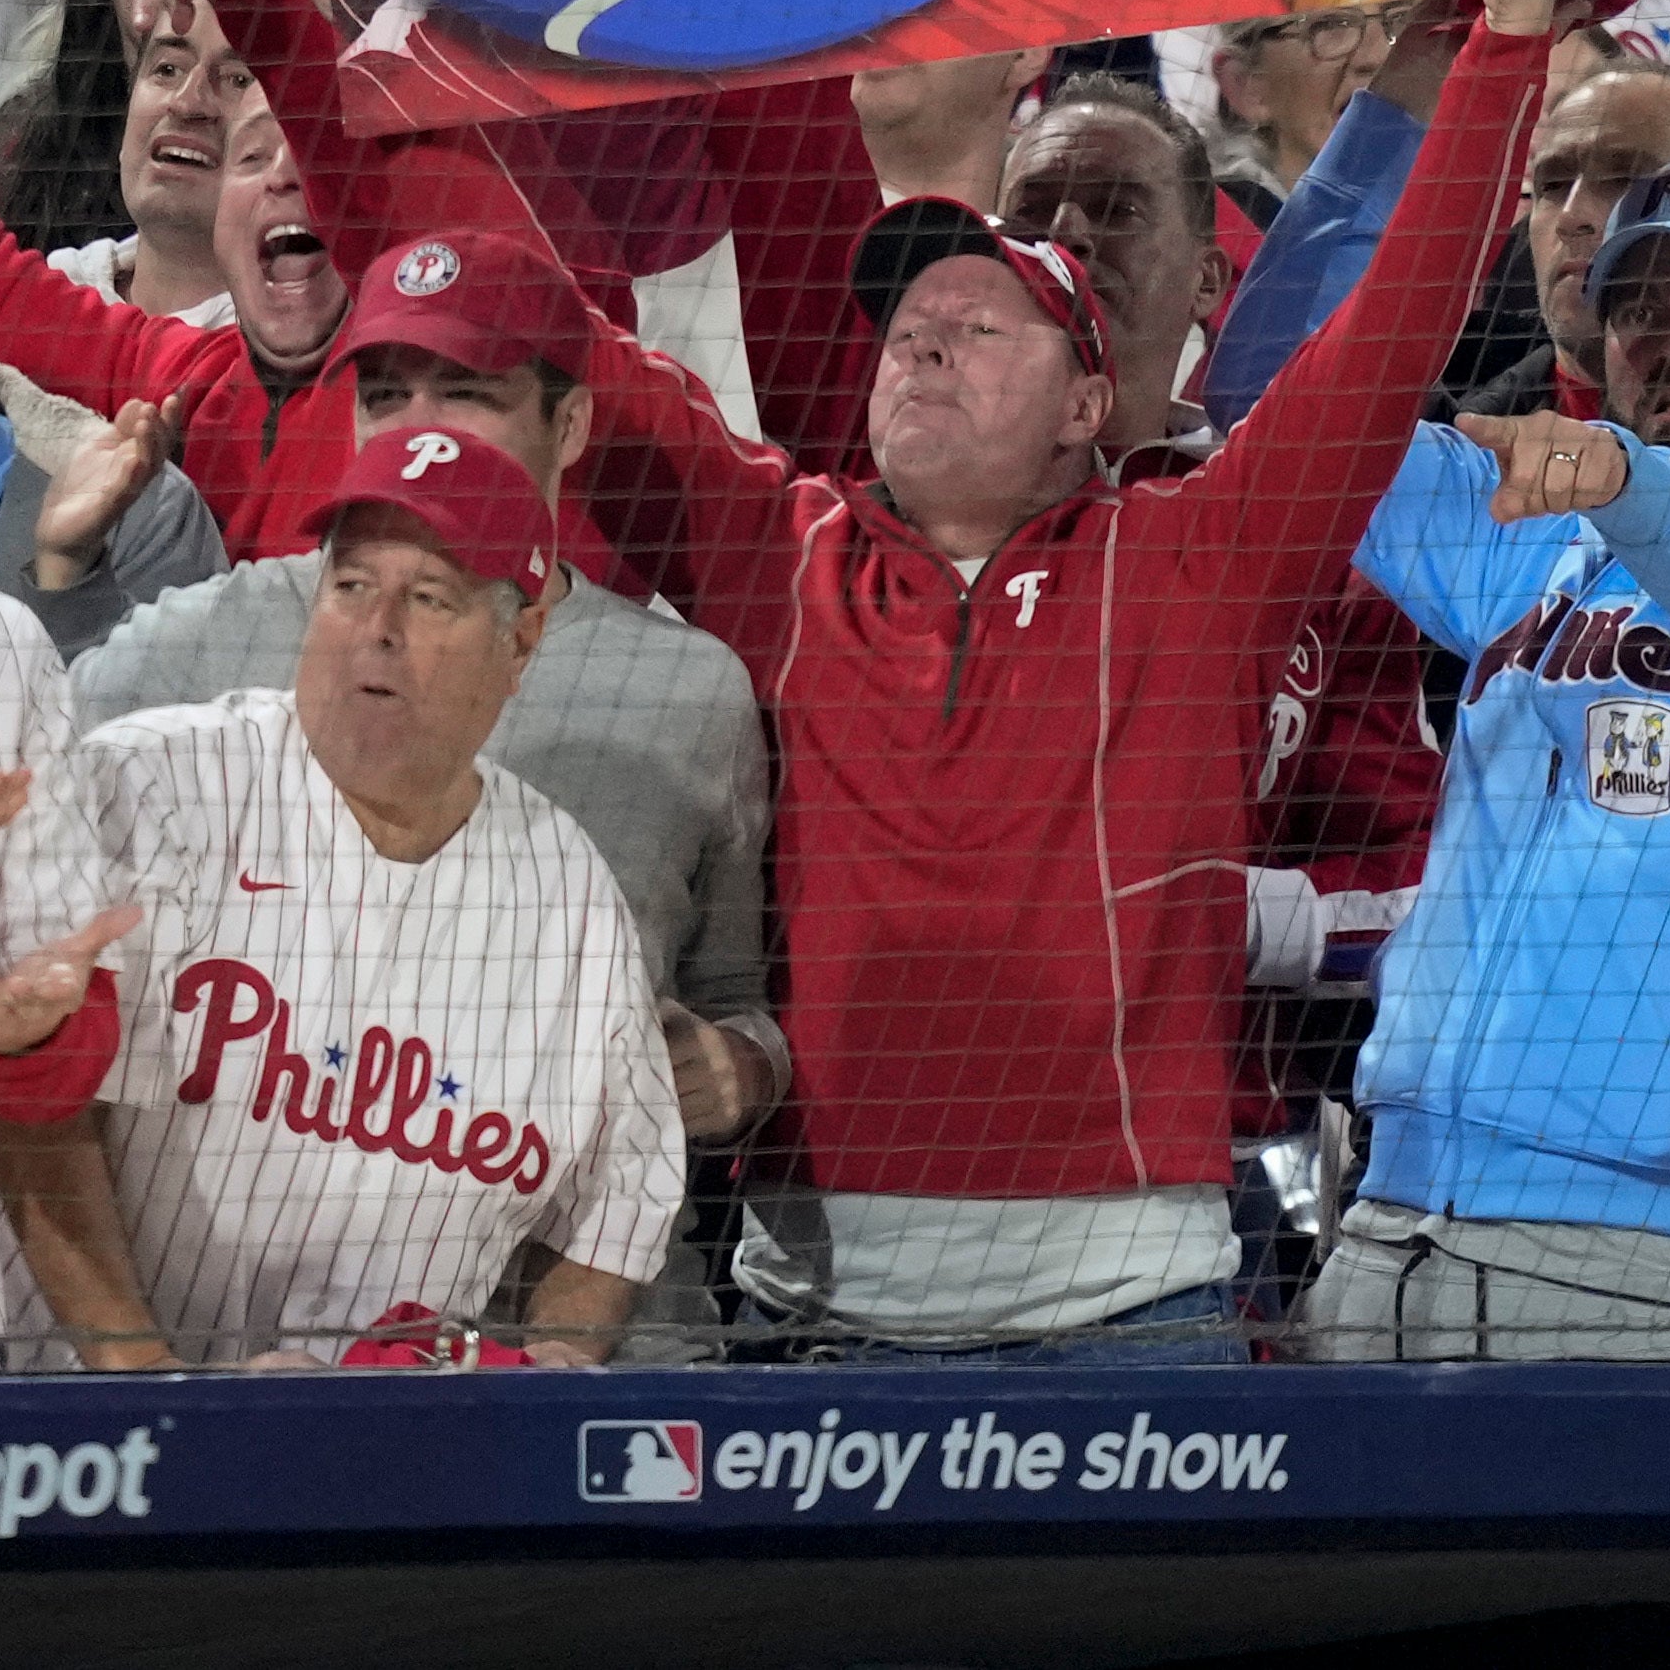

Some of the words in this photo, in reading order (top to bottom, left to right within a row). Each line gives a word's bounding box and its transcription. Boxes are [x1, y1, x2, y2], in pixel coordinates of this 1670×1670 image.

[401, 433, 461, 481] P
[173, 958, 551, 1196] Phillies
[713, 1408, 929, 1512] enjoy
[939, 1412, 1065, 1491] the
[1077, 1412, 1290, 1493] show.
